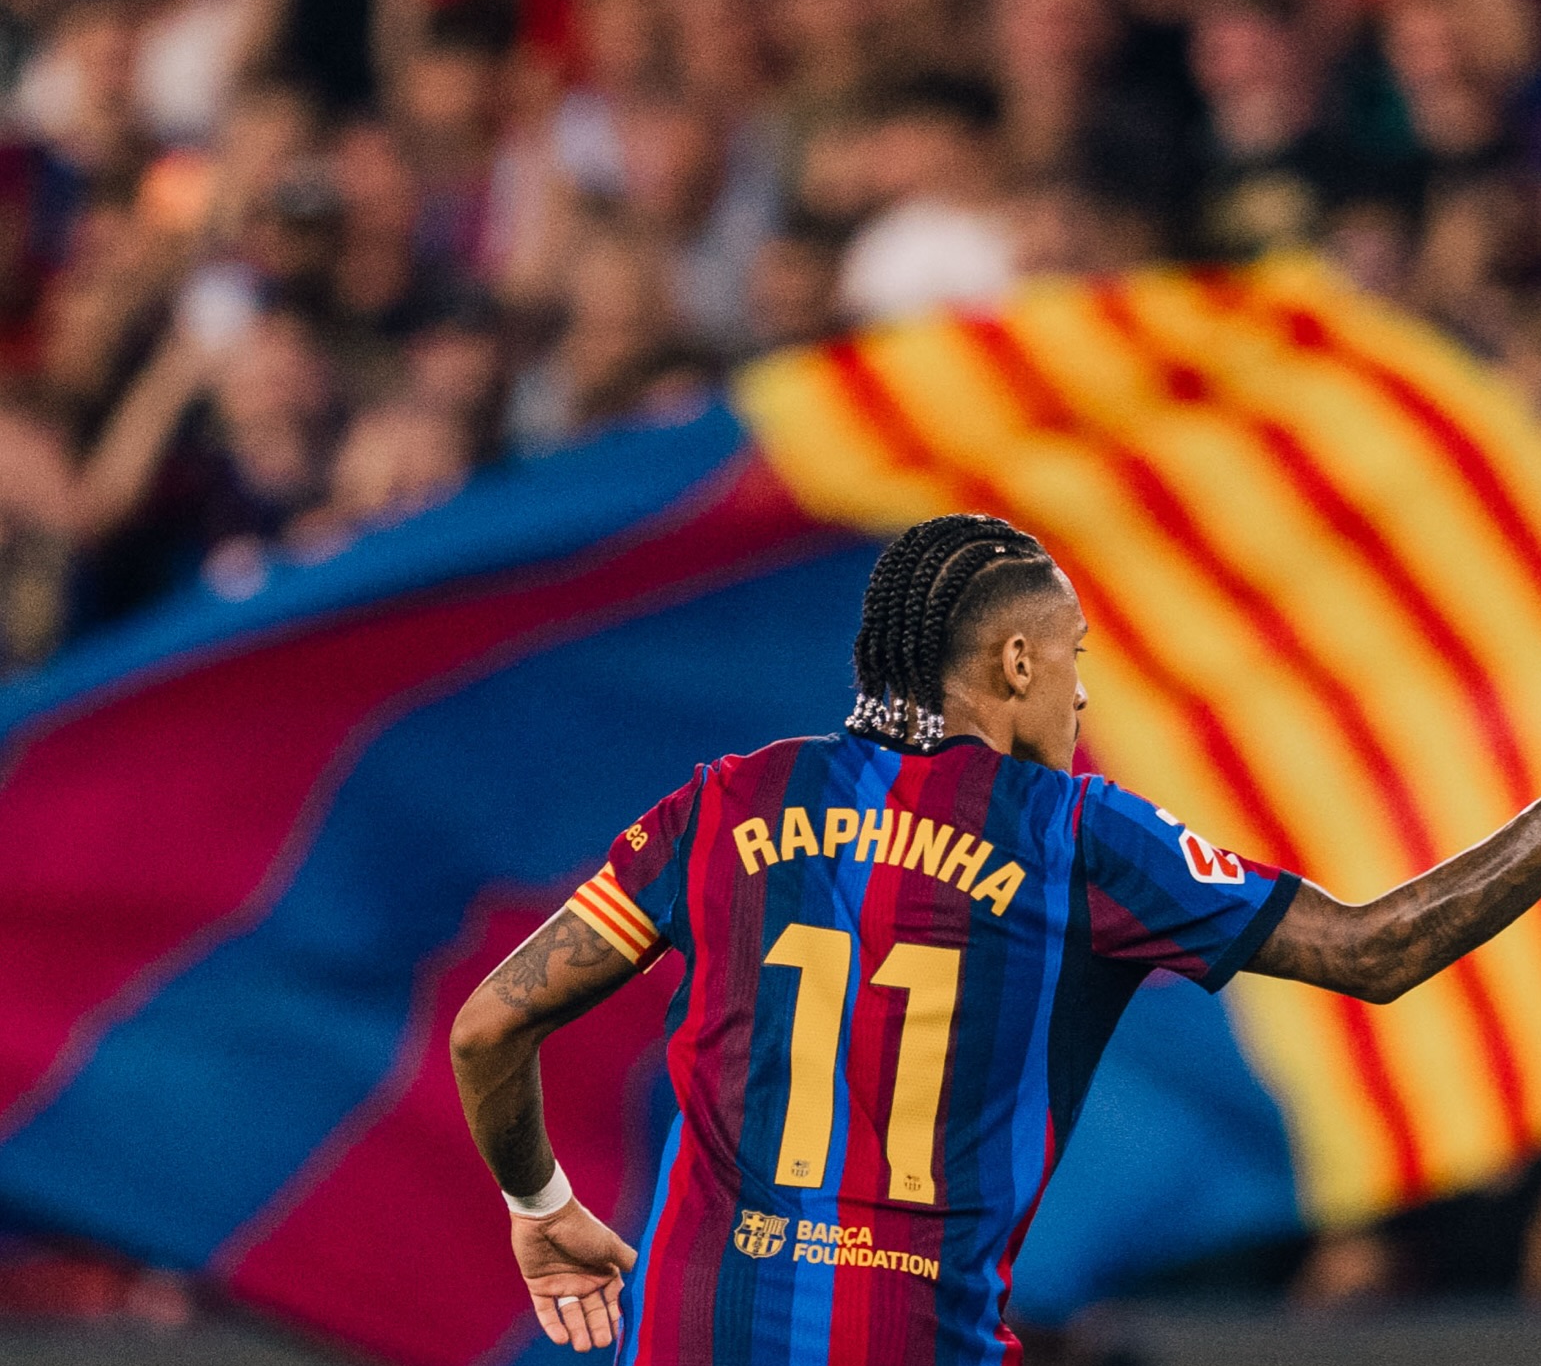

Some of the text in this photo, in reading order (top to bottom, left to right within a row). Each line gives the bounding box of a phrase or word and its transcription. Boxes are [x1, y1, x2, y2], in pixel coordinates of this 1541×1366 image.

[732, 806, 1026, 917] RAPHINHA
[763, 922, 961, 1206] 11
[793, 1242, 940, 1281] FOUNDATION
[796, 1219, 873, 1248] BARÇA
